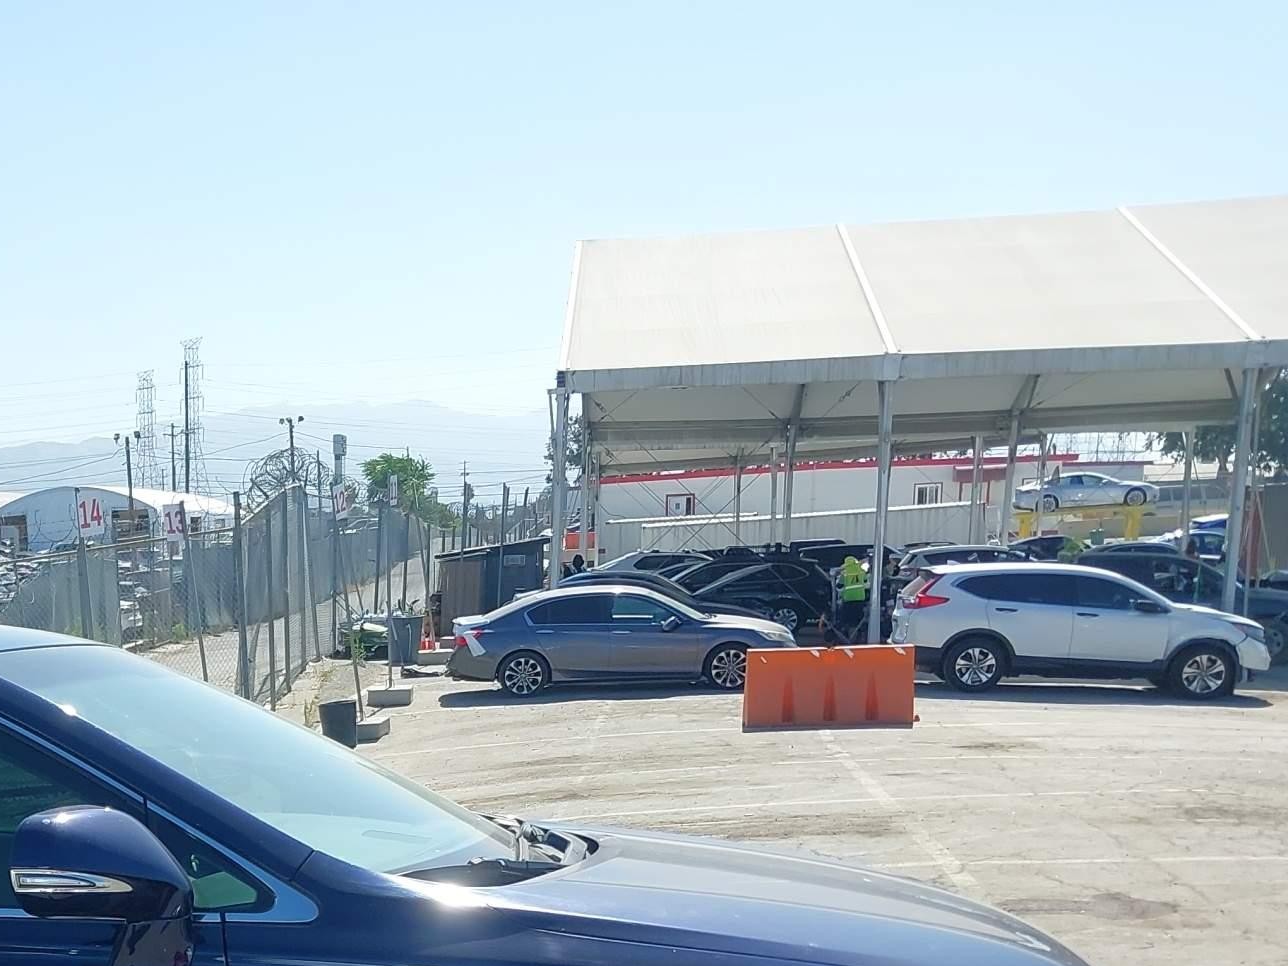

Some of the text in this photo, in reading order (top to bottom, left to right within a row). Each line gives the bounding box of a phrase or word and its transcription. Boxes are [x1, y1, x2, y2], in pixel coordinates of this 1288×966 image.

[79, 498, 102, 529] 14
[335, 491, 347, 515] 12
[164, 510, 184, 534] 13
